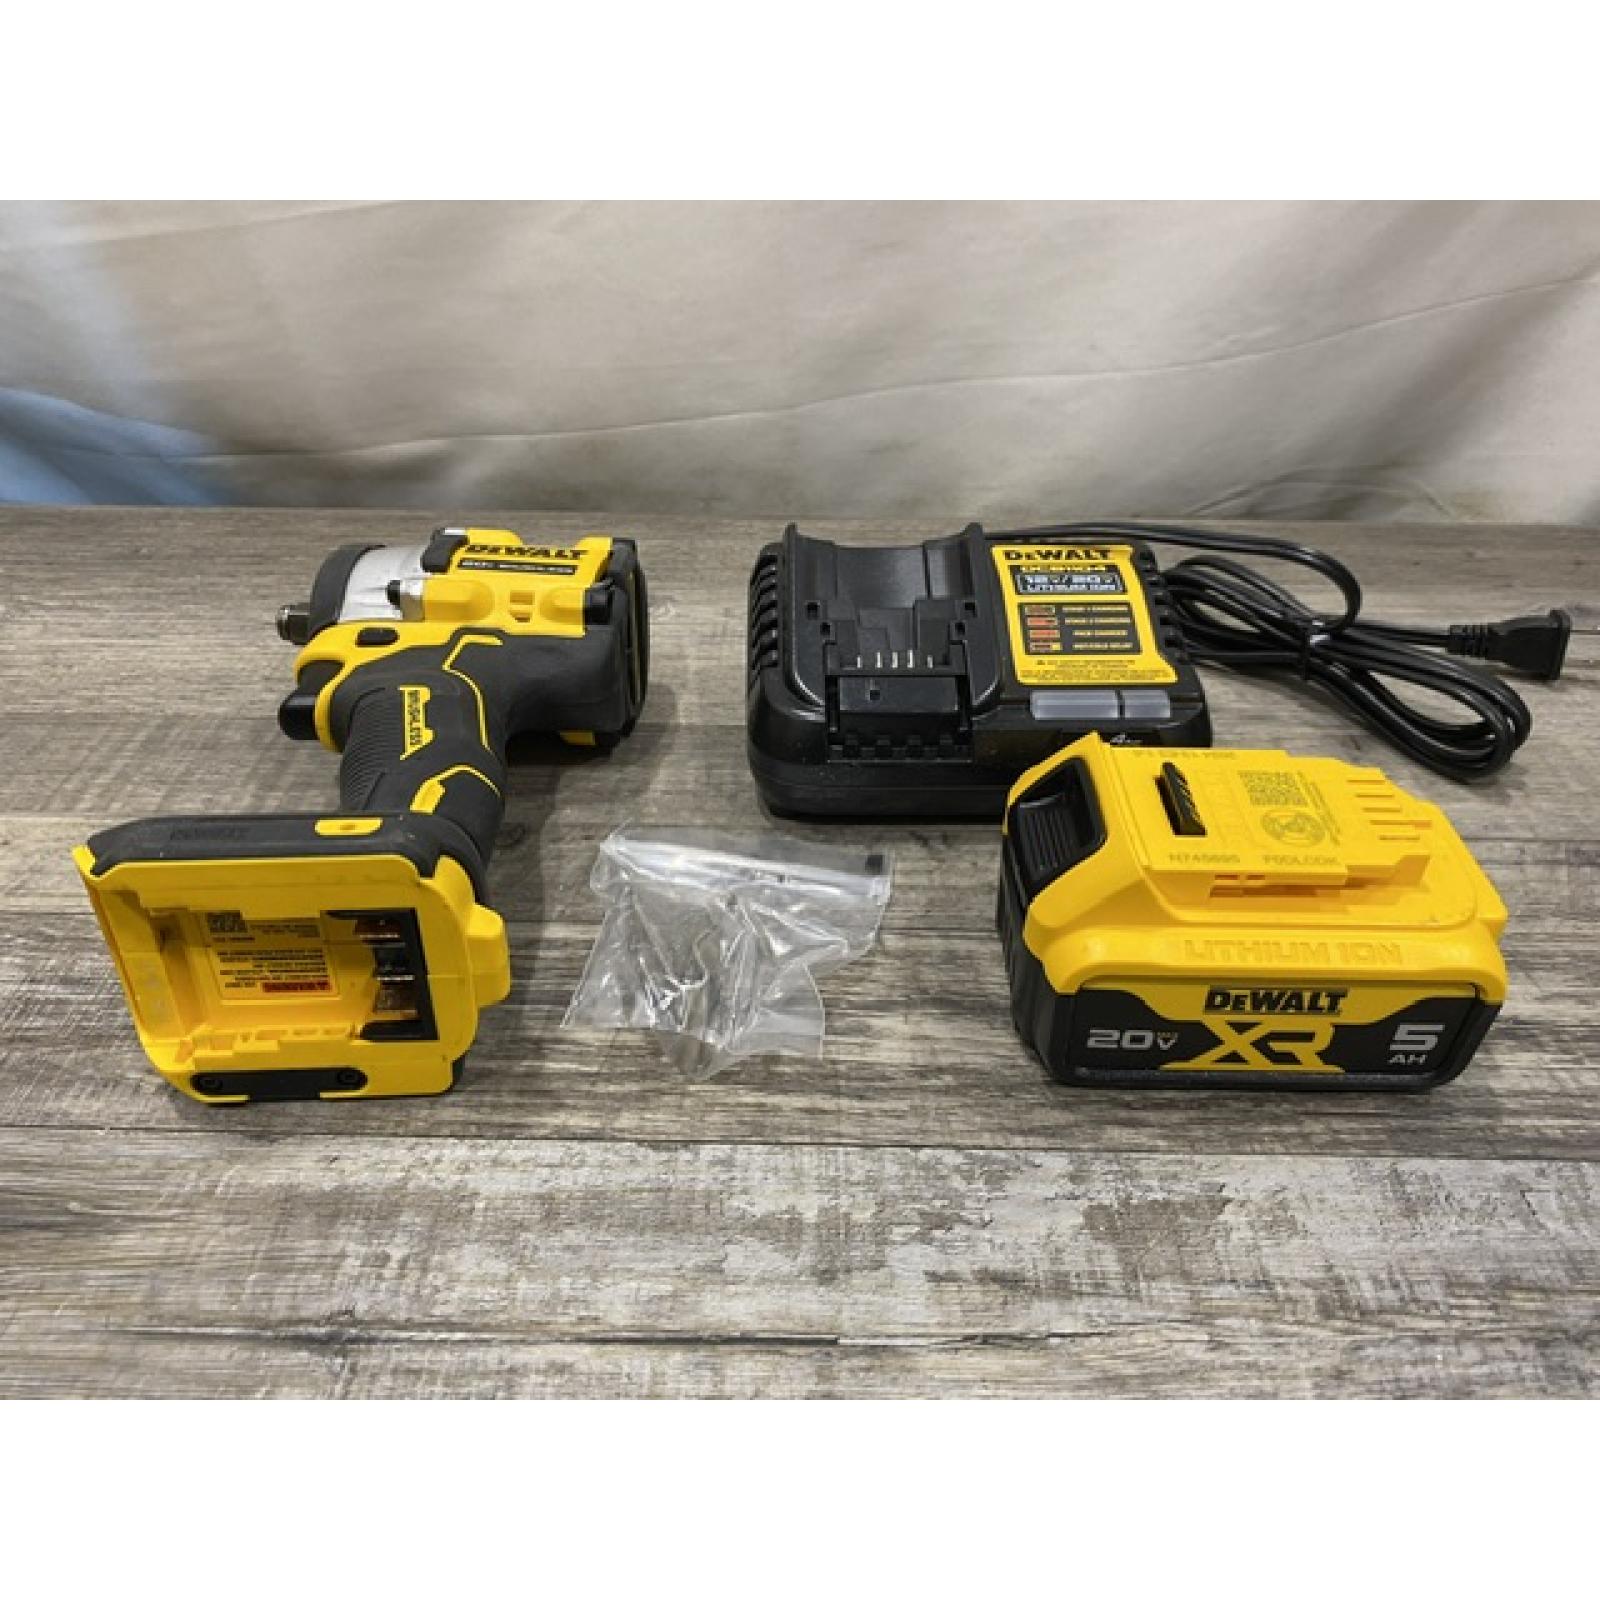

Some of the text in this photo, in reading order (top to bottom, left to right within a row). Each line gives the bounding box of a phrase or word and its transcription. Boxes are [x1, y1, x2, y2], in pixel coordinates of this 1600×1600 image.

[1184, 939, 1404, 965] LITHIUM ION
[1204, 988, 1348, 1012] DEWALT
[1165, 1020, 1346, 1072] XR
[1389, 1024, 1446, 1051] 5
